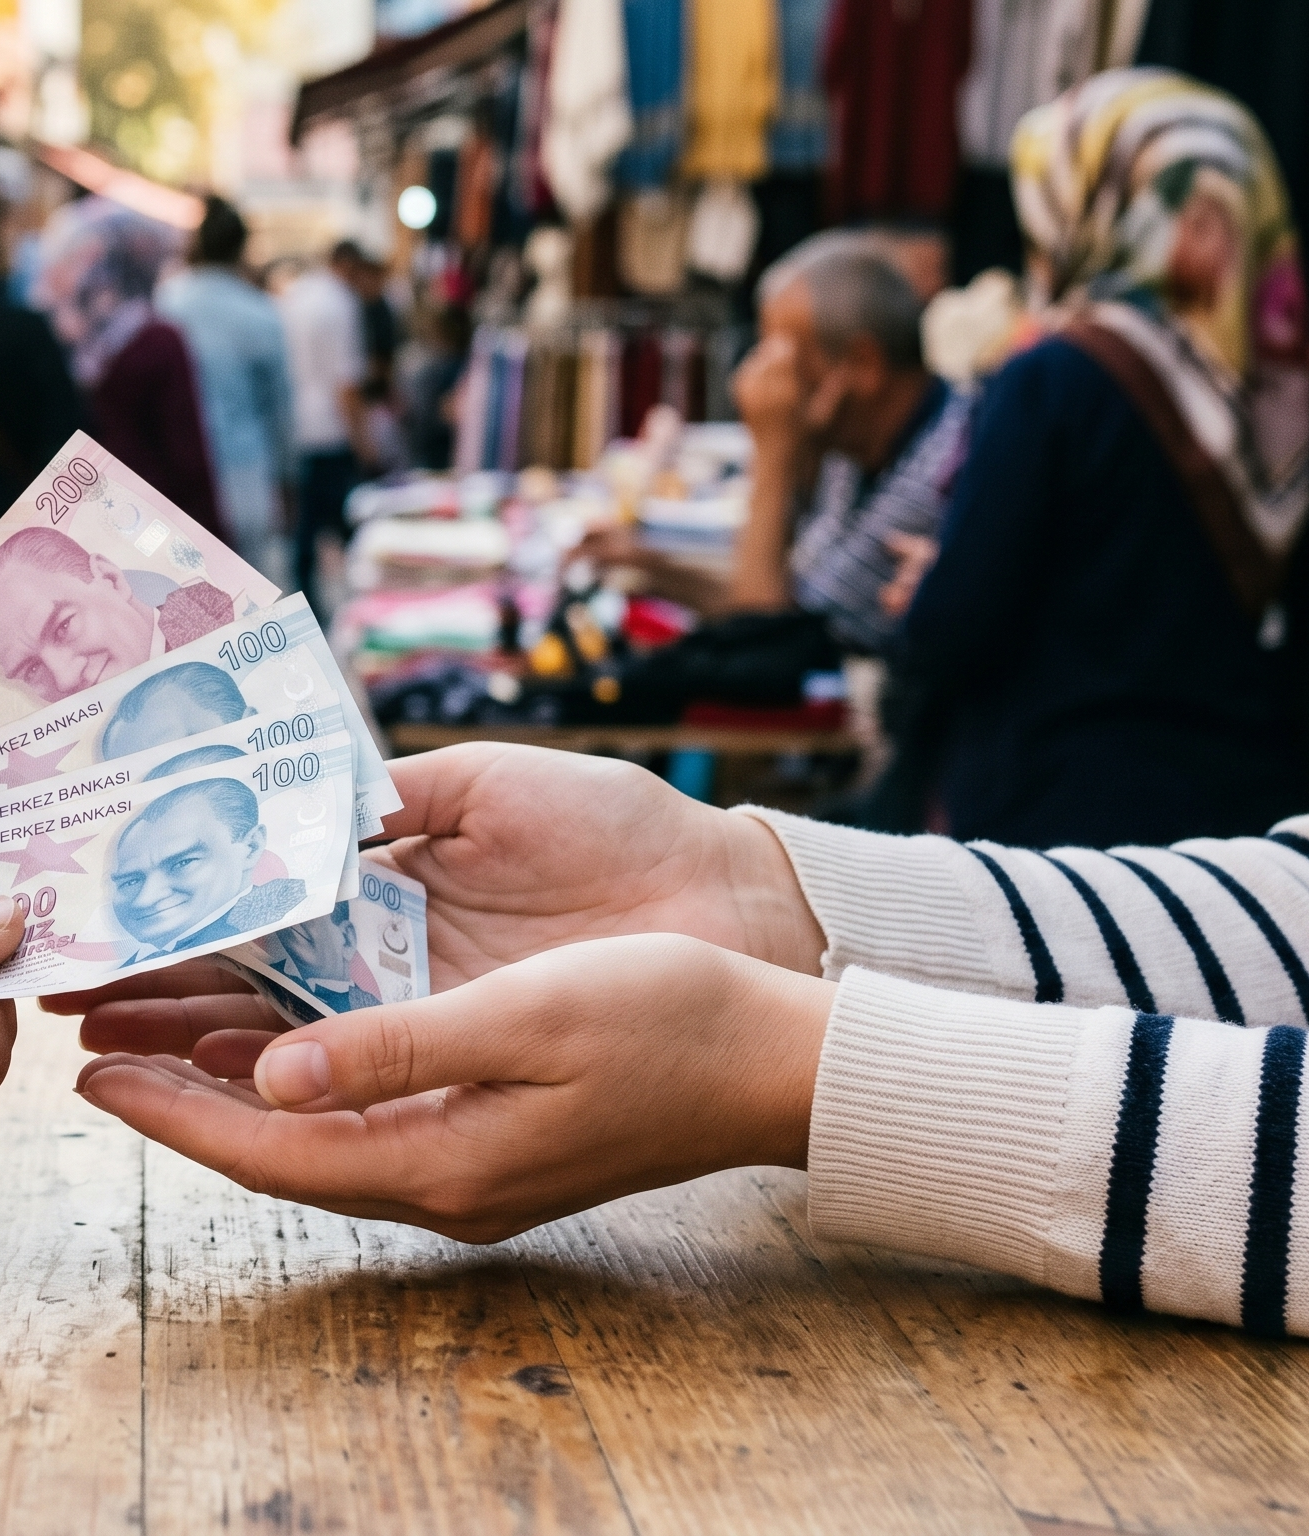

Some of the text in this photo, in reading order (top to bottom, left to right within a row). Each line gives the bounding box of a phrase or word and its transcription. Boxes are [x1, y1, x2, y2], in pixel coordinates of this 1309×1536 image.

[36, 457, 99, 525] 200
[218, 621, 287, 671] 100
[33, 700, 105, 741] BANKASI
[247, 713, 315, 753] 100
[58, 770, 131, 802] BANKASI
[252, 752, 320, 792] 100
[60, 800, 132, 830] BANKASI
[11, 886, 57, 920] 00
[362, 873, 401, 911] 00
